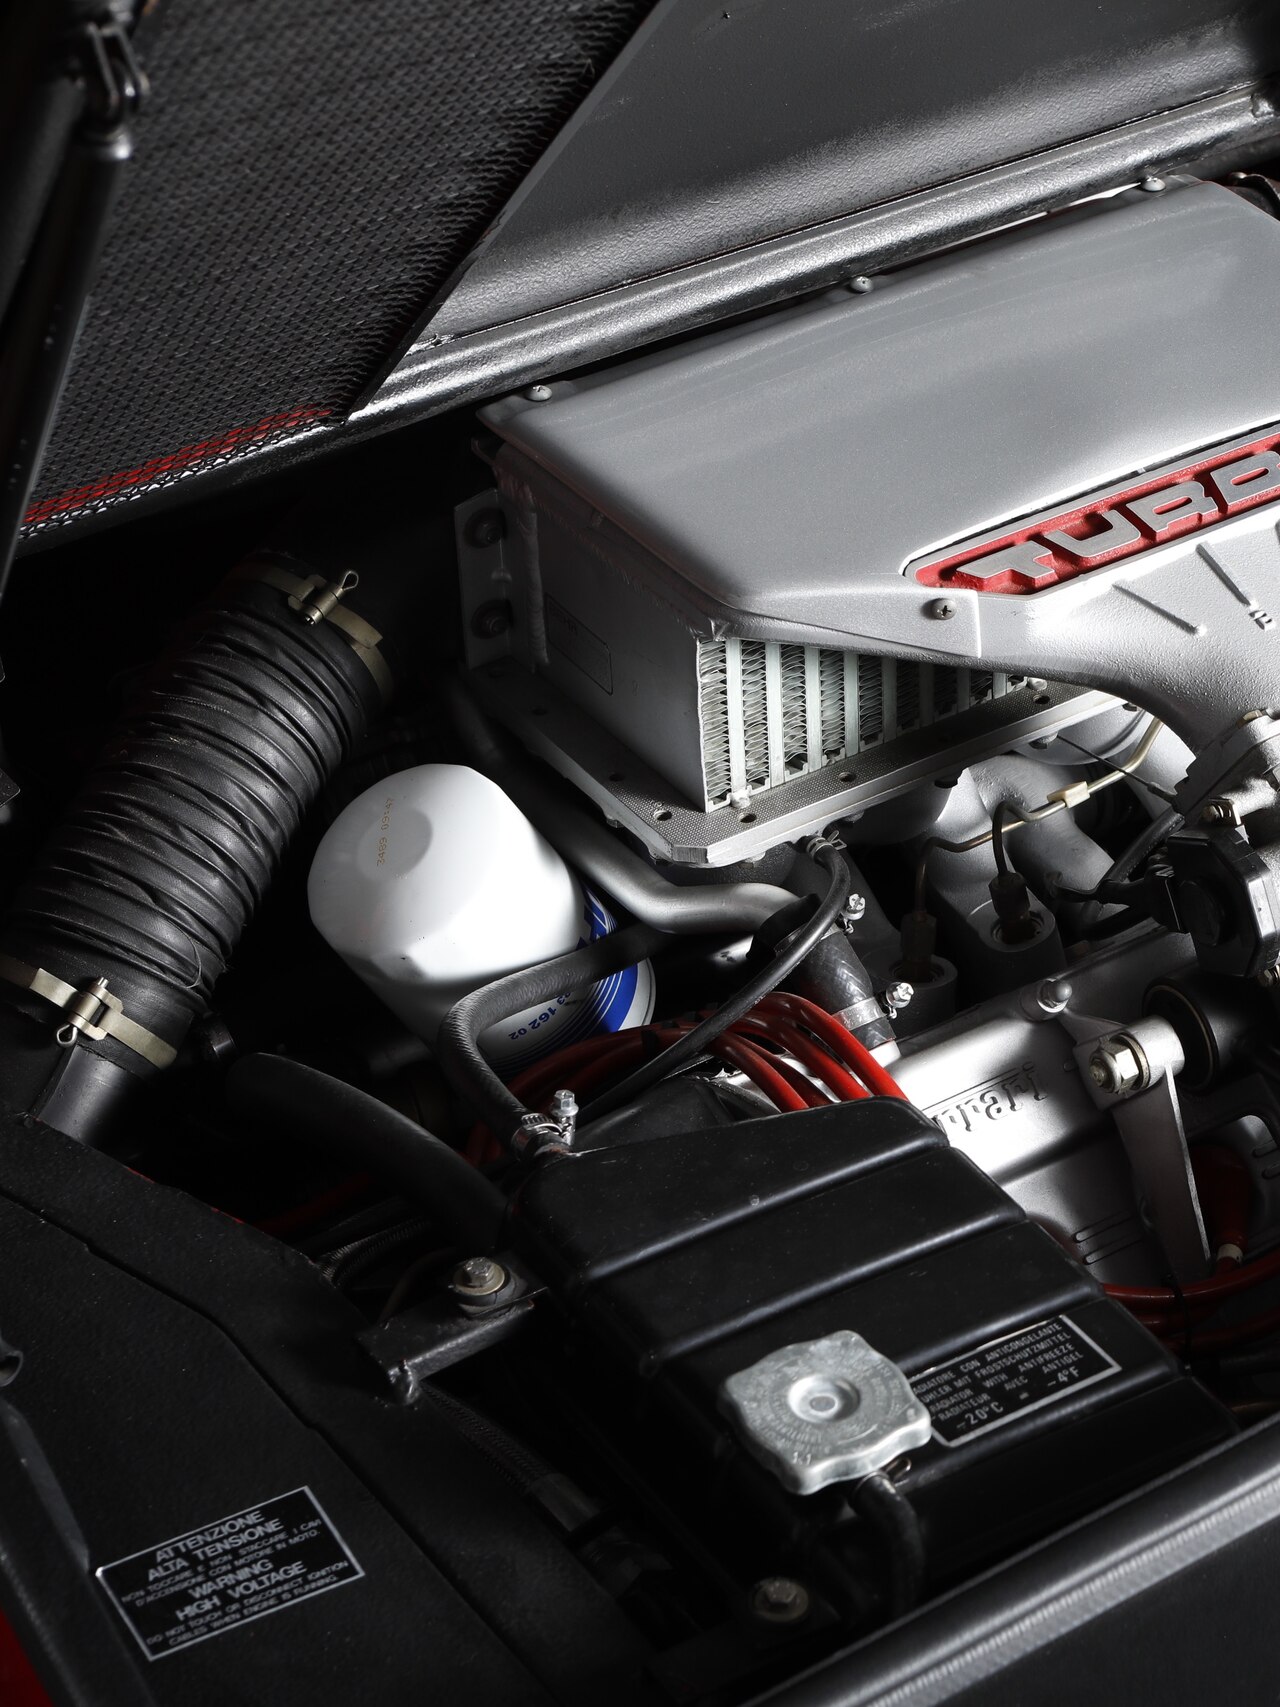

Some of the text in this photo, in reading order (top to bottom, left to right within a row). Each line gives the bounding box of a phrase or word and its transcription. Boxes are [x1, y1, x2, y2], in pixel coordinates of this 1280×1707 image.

[507, 1027, 528, 1041] 02
[528, 1004, 557, 1030] 162
[908, 1322, 1062, 1395] ADIATORE CON ANTICONGELANTE
[920, 1331, 1071, 1403] UHLER MIT FROSTSCHUTZMITTEL
[928, 1342, 1074, 1413] RADIATOR WITH ANTIFREEZE
[1003, 1375, 1028, 1391] AVEC
[1041, 1350, 1083, 1374] ANTIGEL
[147, 1517, 284, 1581] ALTA TENSIONE
[155, 1509, 265, 1563] ATTENZIONE
[237, 1531, 288, 1555] STACCARE
[187, 1558, 273, 1598] WARNING
[208, 1563, 232, 1576] CON
[233, 1546, 274, 1566] MOTORE
[175, 1560, 307, 1621] HIGH VOLTAGE
